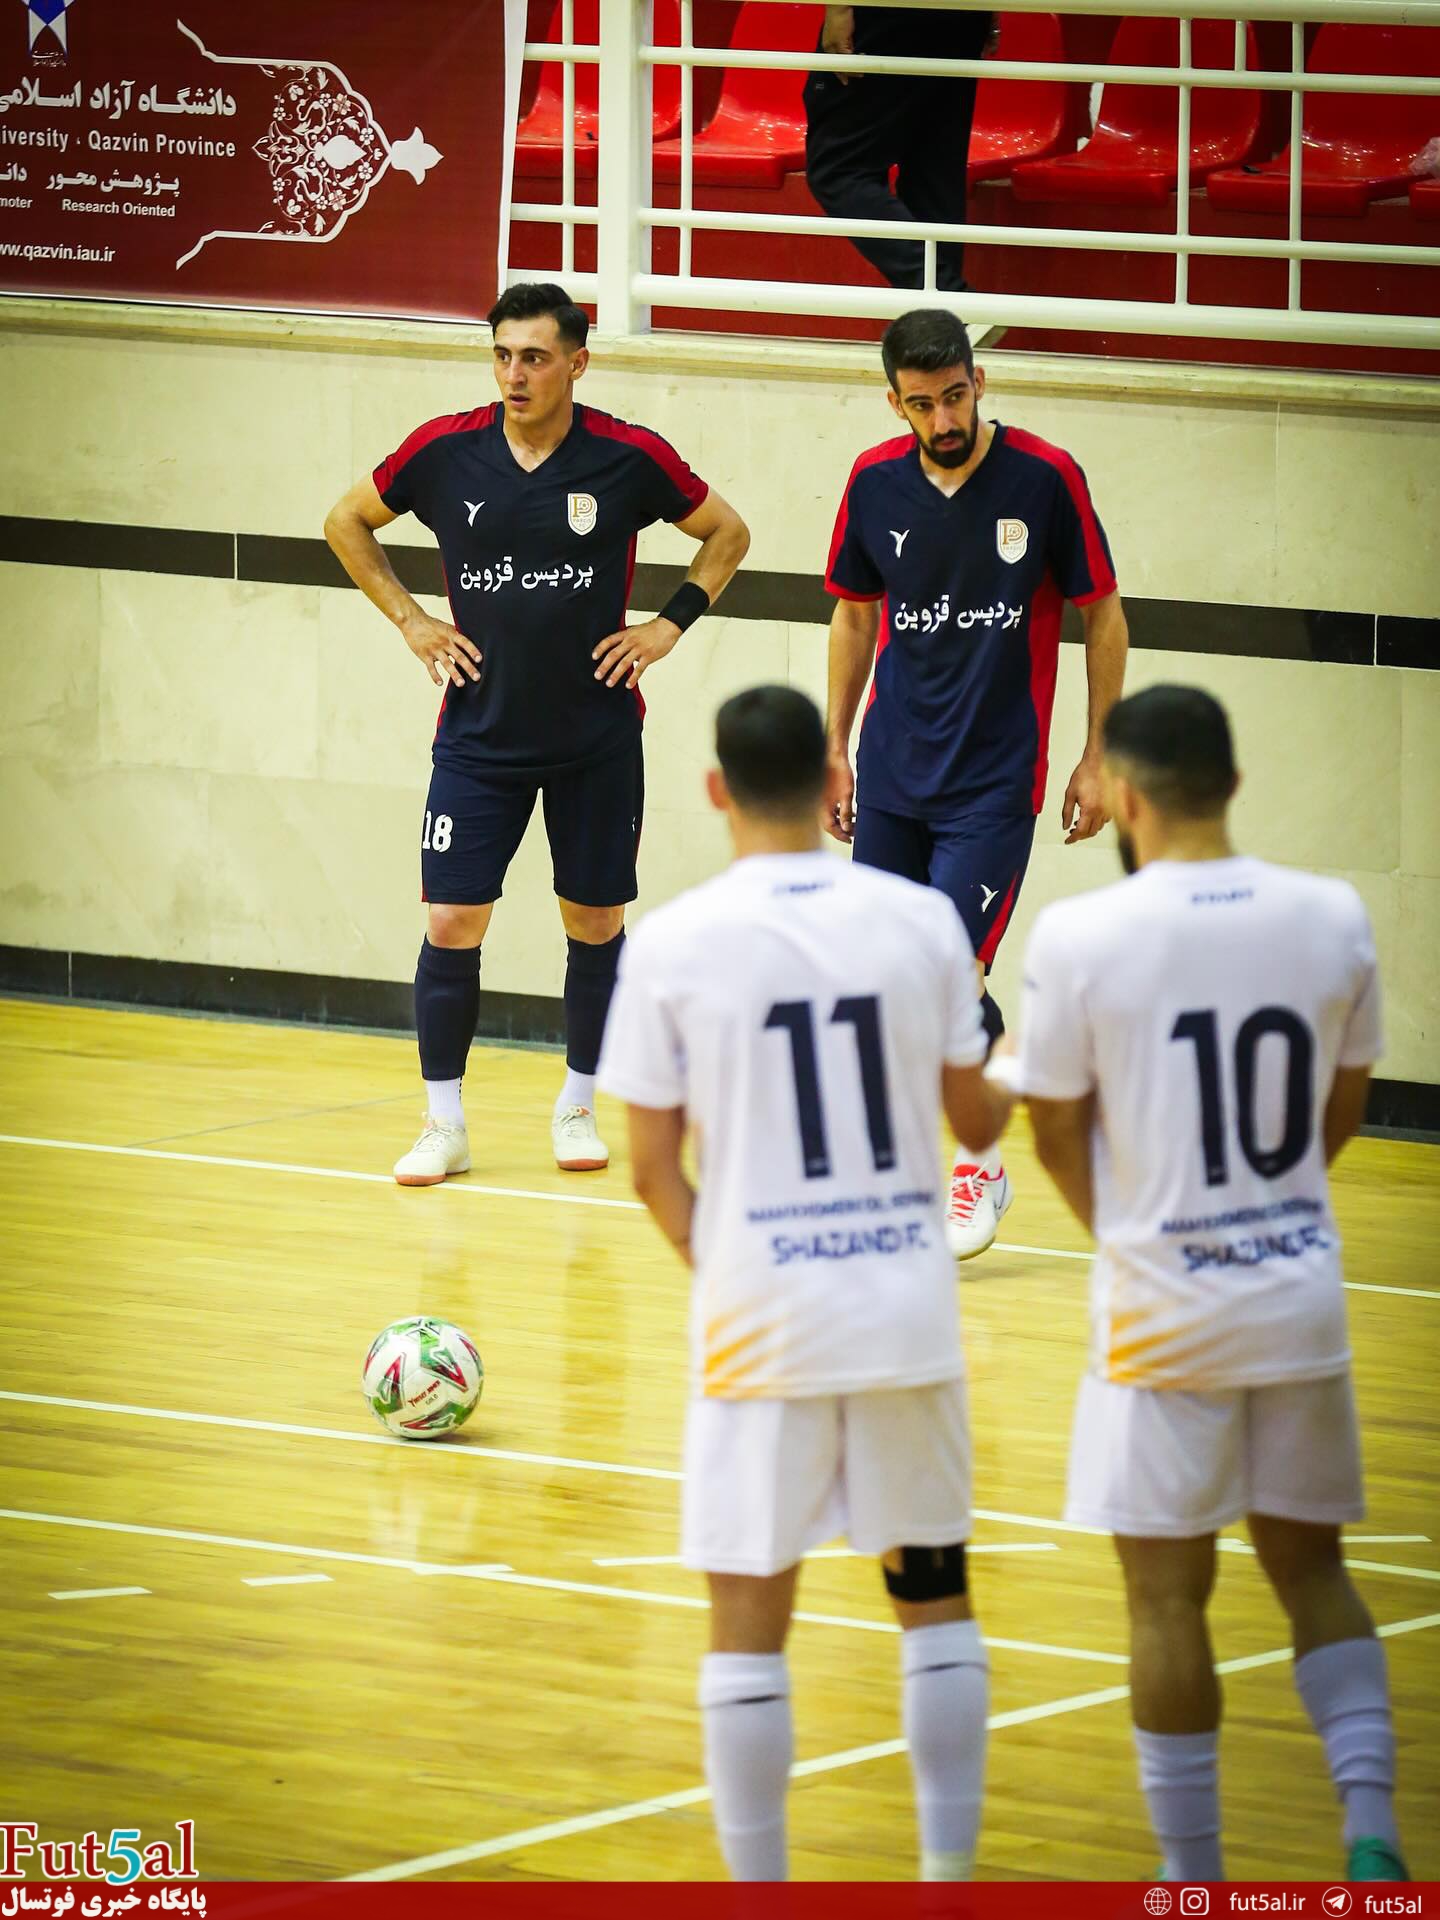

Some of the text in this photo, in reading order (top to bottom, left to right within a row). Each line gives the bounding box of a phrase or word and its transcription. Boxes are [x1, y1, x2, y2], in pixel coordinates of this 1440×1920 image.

[90, 80, 136, 119] آزاد
[138, 84, 237, 117] دانشگاه
[88, 130, 149, 153] Qazvin
[156, 133, 236, 157] Province
[45, 169, 180, 198] پژوهش محور
[62, 199, 176, 217] Research Oriented
[460, 556, 594, 592] پردیس قزوین
[895, 594, 1023, 633] پردیس قزوین
[422, 810, 454, 853] 18
[764, 995, 896, 1180] 11
[1170, 1006, 1314, 1188] 10
